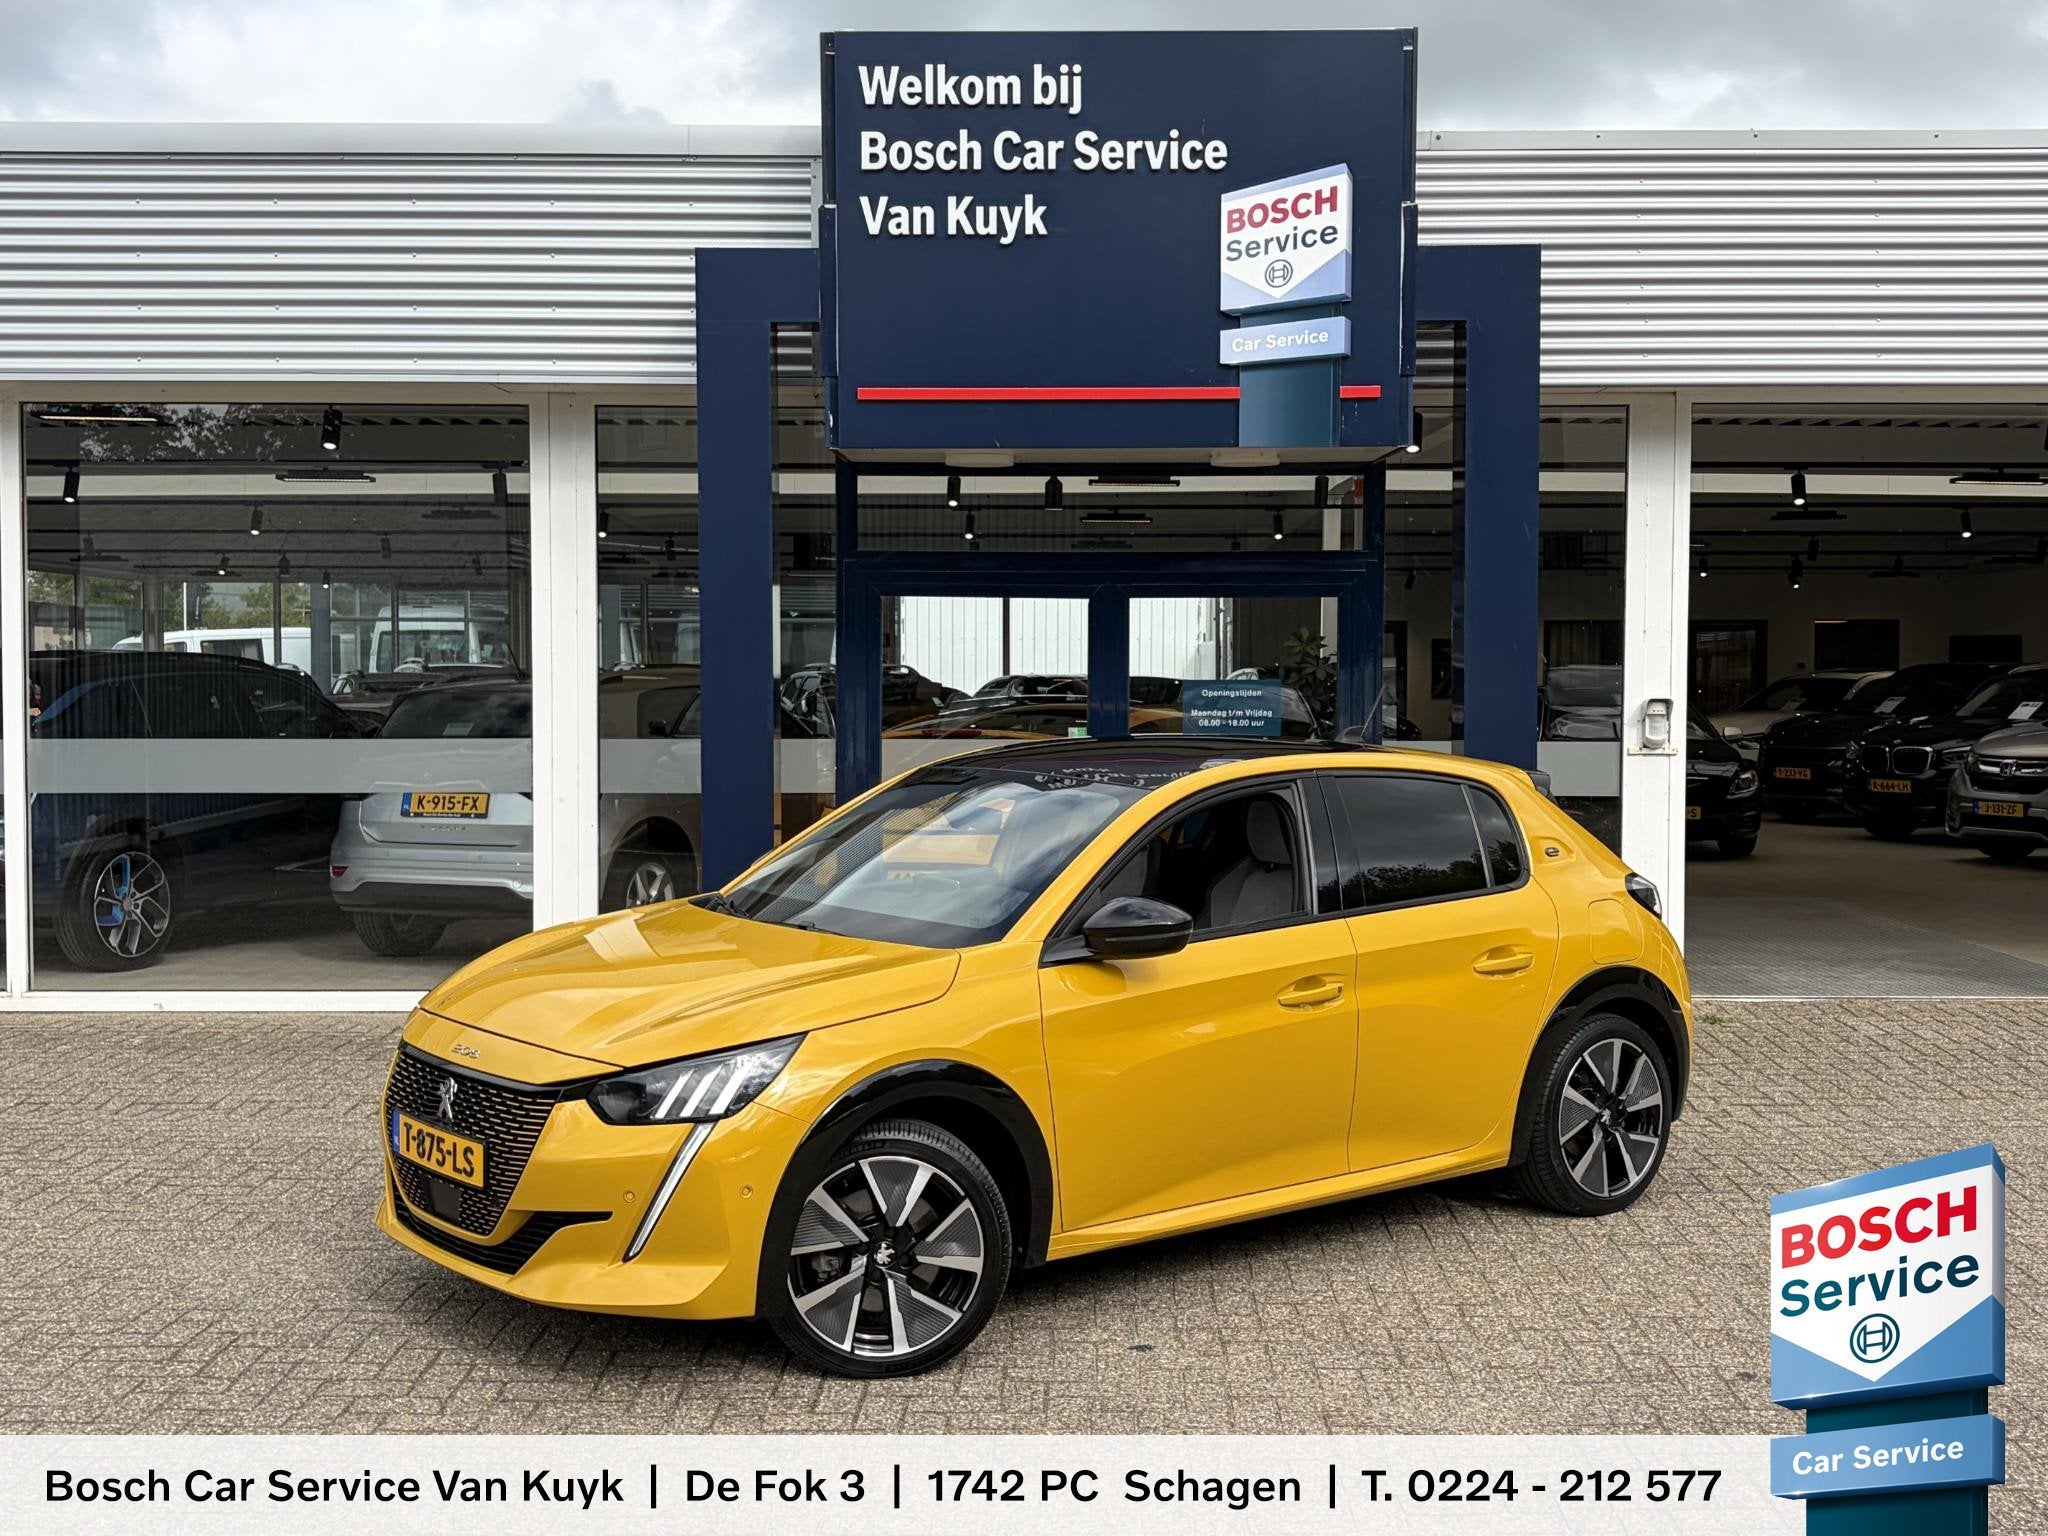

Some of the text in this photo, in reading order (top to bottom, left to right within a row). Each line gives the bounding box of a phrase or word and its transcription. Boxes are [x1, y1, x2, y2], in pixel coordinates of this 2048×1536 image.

[858, 63, 1083, 115] Welkom bij
[860, 129, 1228, 171] Bosch Car Service
[859, 194, 1048, 245] Van Kuyk
[1227, 186, 1338, 234] BOSCH
[1226, 225, 1338, 262] Service
[1232, 330, 1329, 352] Car Service
[1201, 689, 1262, 698] Openingstijden
[1190, 709, 1273, 718] Maandag t/m Vrijdag
[417, 795, 480, 811] K-915-FX
[403, 1121, 475, 1178] T-875-LS
